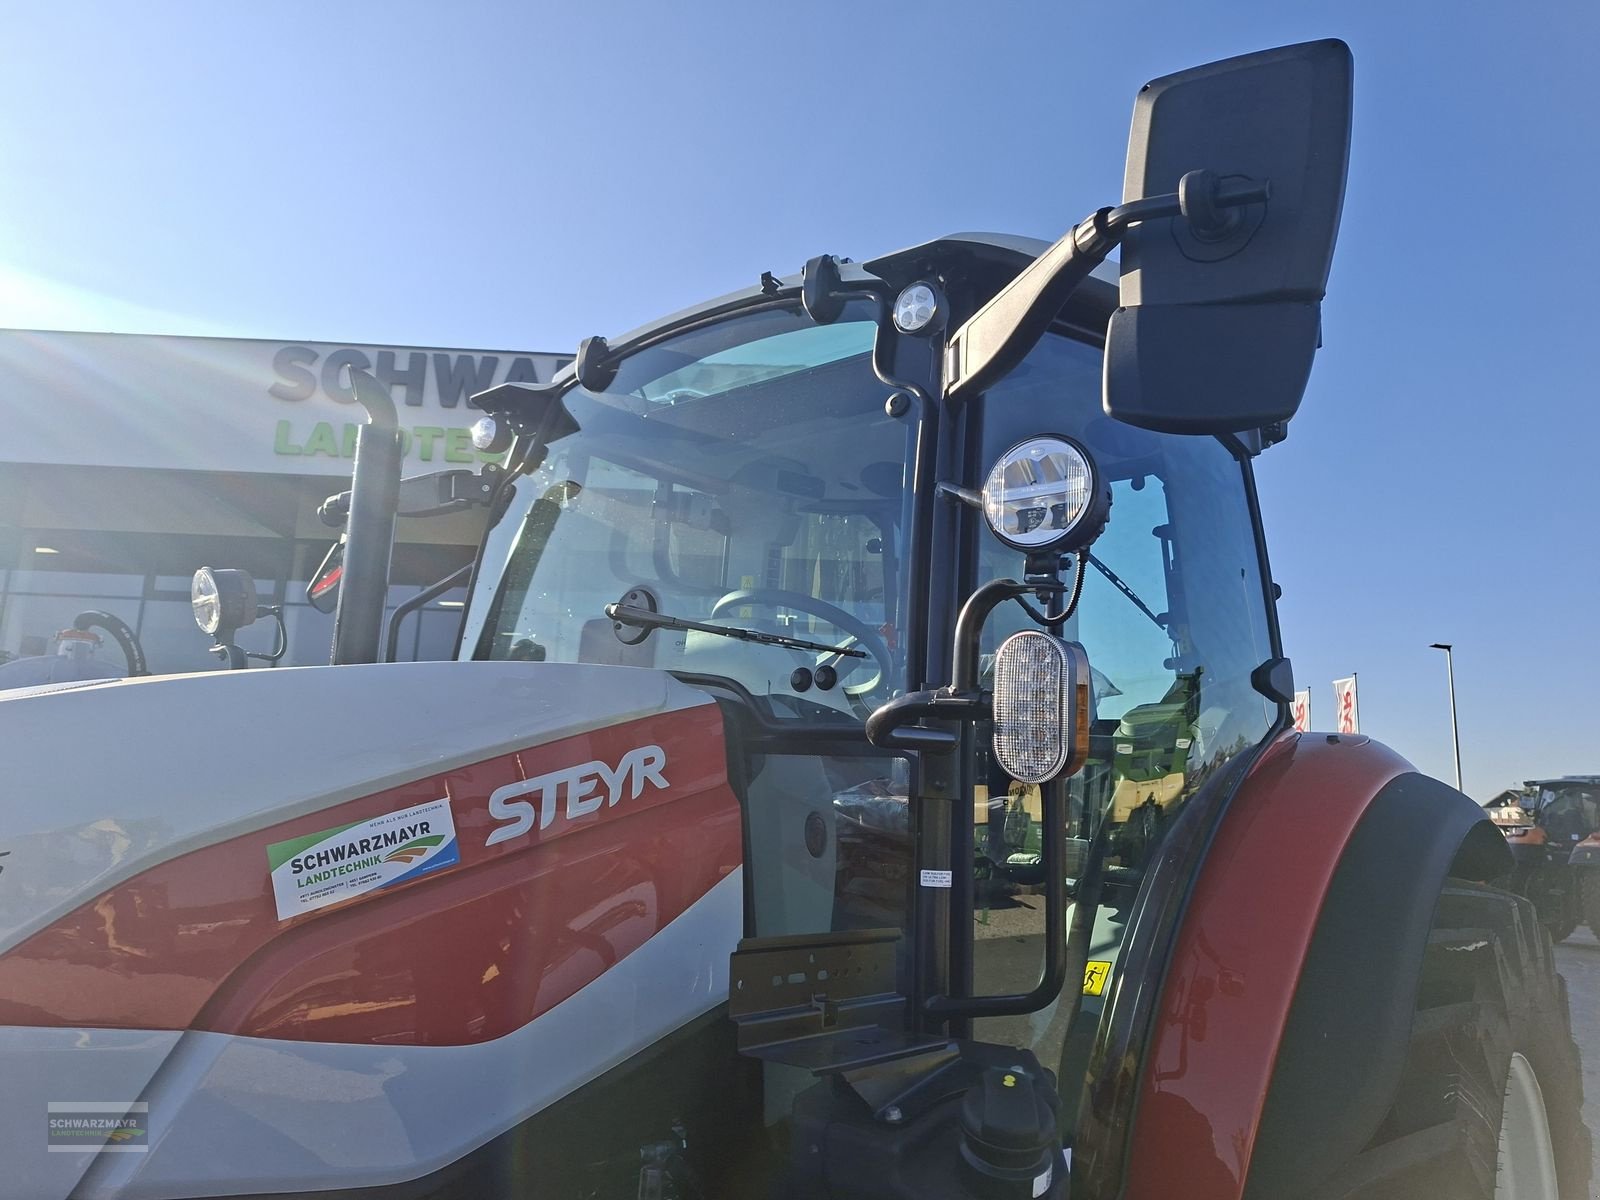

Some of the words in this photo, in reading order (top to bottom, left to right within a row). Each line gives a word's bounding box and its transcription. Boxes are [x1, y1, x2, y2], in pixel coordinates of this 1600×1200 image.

[485, 744, 670, 847] STEYR
[290, 821, 431, 875] SCHWARZMAYR
[296, 854, 382, 889] LANDTECHNIK
